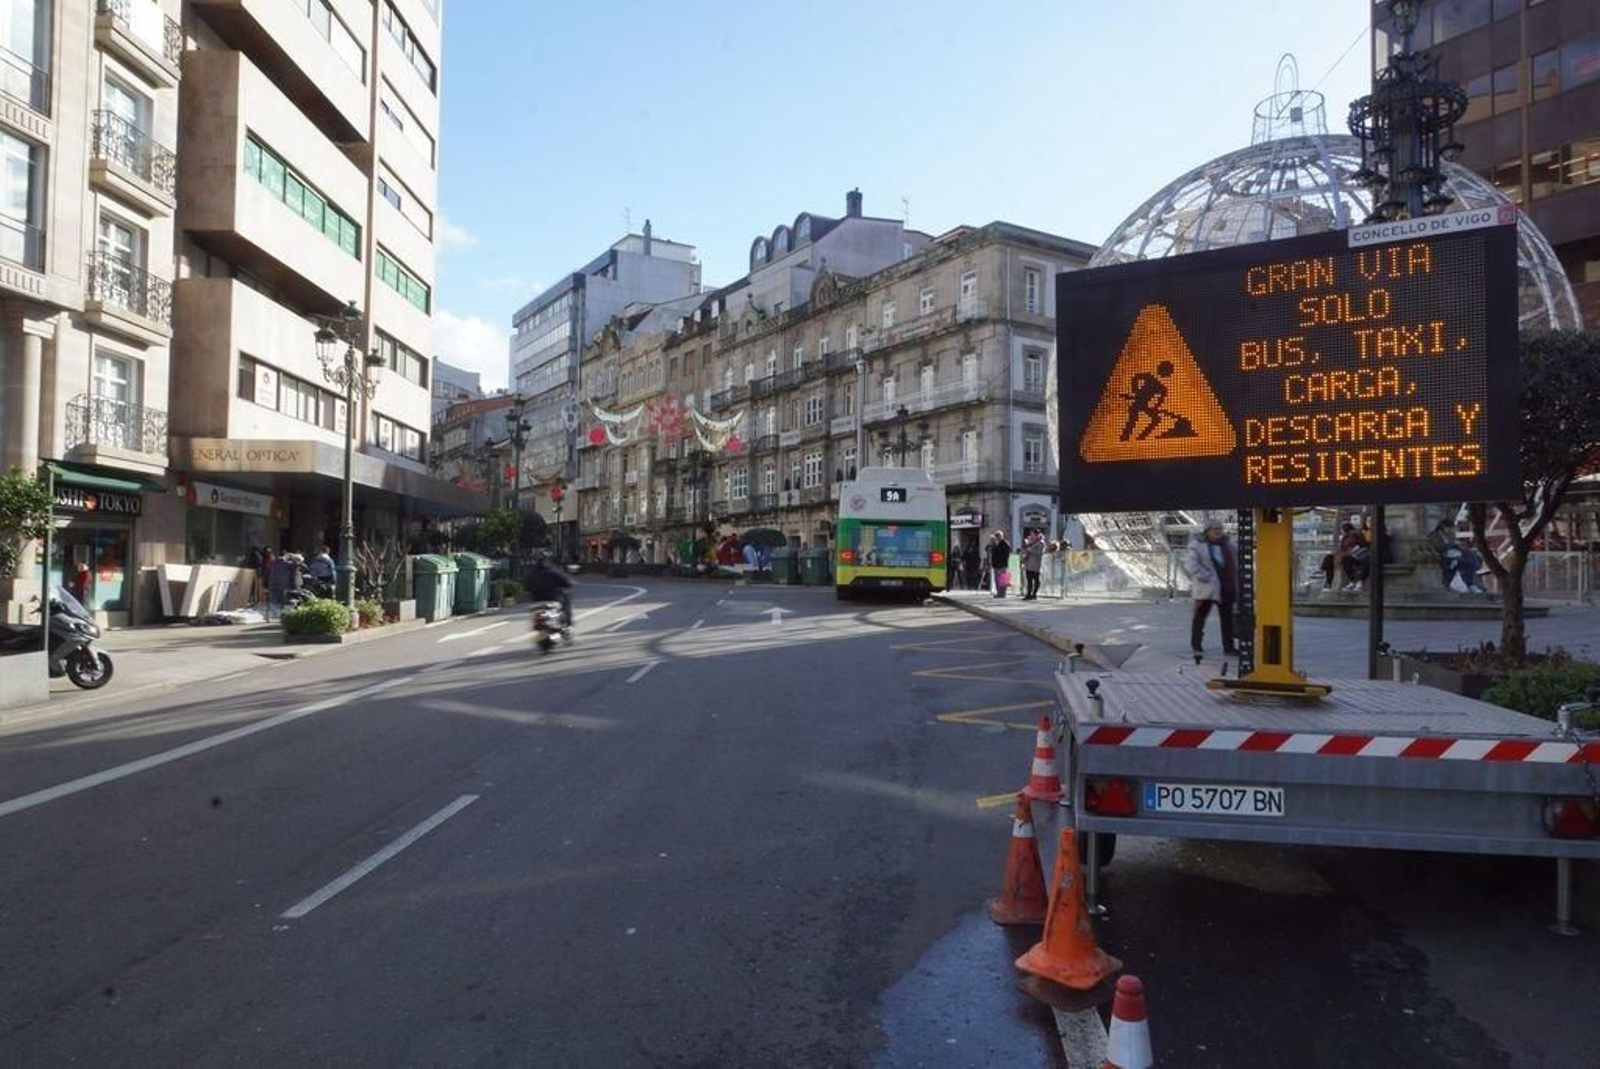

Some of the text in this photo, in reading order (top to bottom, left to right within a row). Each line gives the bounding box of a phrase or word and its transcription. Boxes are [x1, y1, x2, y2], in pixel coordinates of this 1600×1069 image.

[1353, 211, 1491, 241] CONCELLO DE VIGO
[1246, 242, 1432, 296] GRAN VIA
[1298, 288, 1391, 327] SOLO
[1240, 321, 1468, 371] BUS, TAXI,
[1284, 366, 1417, 404] CARGA,
[1246, 403, 1481, 448] DESCARGA Y
[192, 449, 239, 462] ENERAL
[1246, 444, 1482, 485] RESIDENTES
[97, 492, 140, 513] TOKYO
[886, 490, 900, 501] 9A
[1157, 786, 1282, 813] PO 5707 BN
